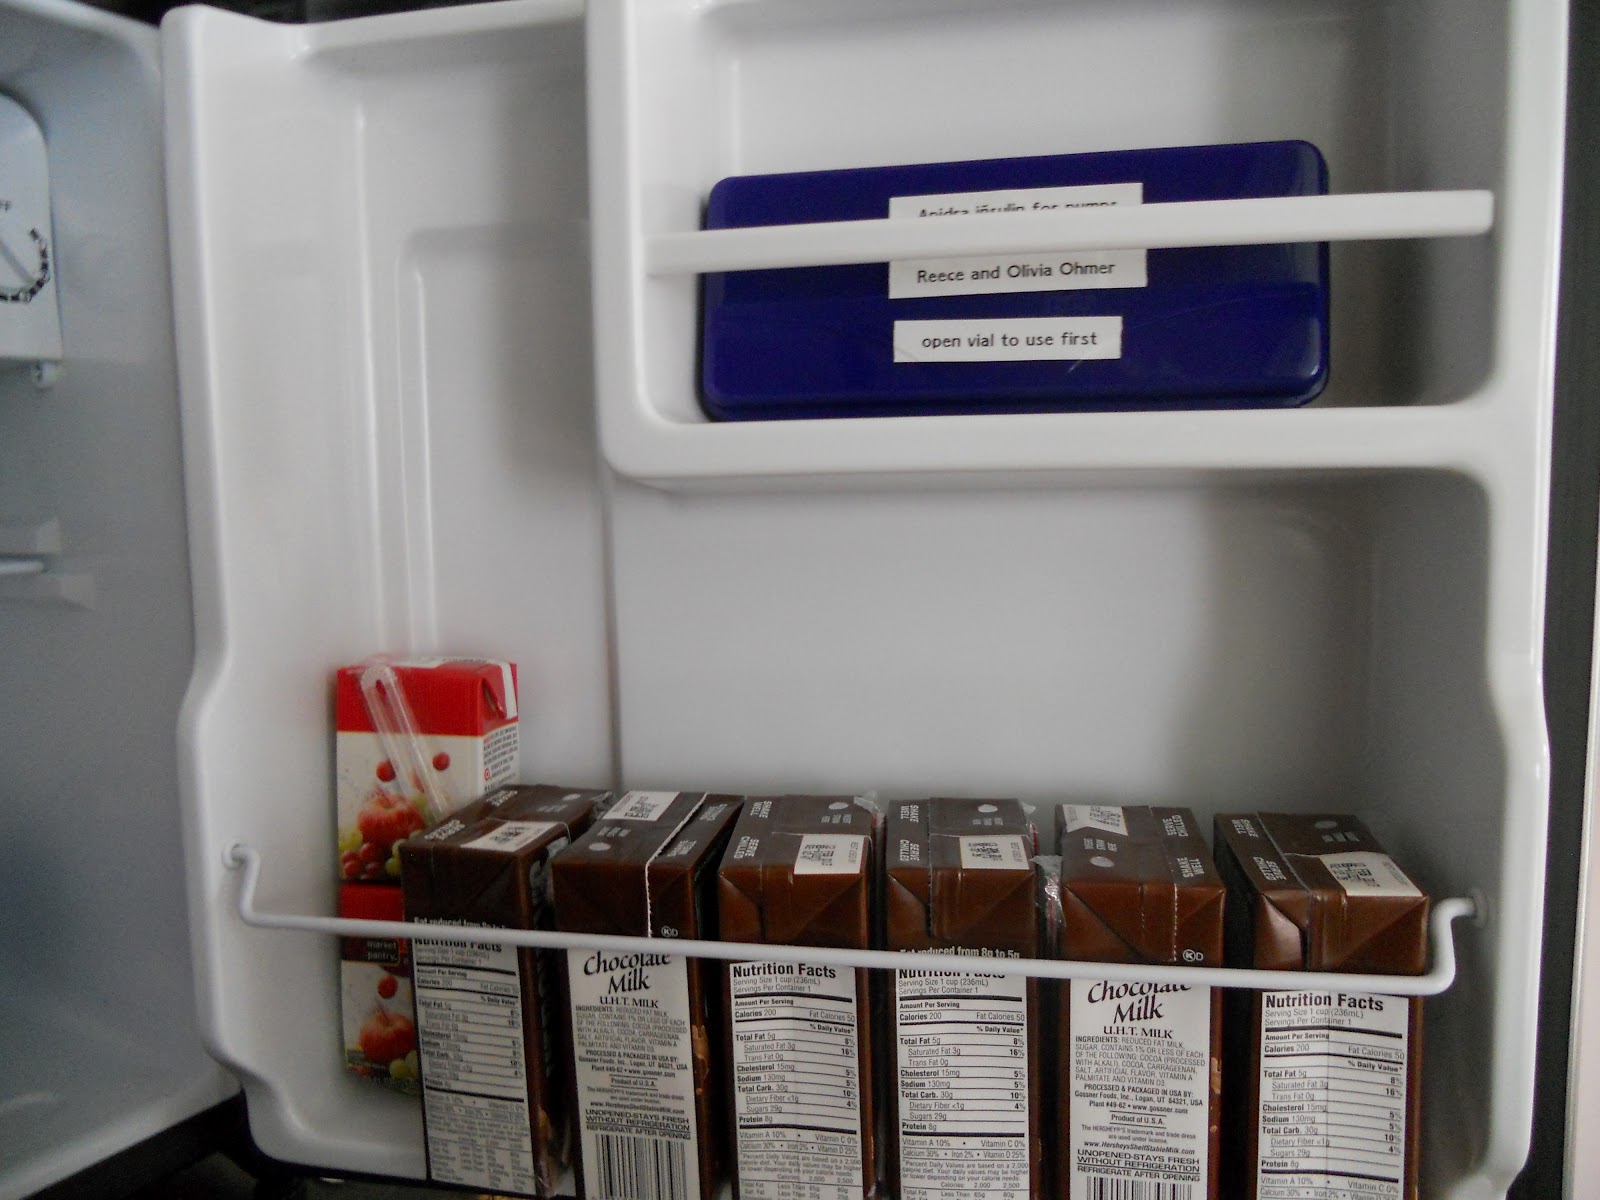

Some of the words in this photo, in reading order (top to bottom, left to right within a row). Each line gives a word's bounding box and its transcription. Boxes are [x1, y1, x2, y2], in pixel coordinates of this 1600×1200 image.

[917, 270, 964, 283] Reece
[971, 266, 1000, 280] and
[1007, 264, 1052, 278] Olivia
[1060, 262, 1115, 276] Ohmer
[922, 336, 961, 349] open
[968, 334, 993, 347] vial
[1001, 334, 1019, 346] to
[1027, 335, 1053, 346] use
[1061, 332, 1097, 345] first
[759, 801, 772, 818] SHAKE
[910, 805, 918, 822] SHAKE
[745, 839, 759, 857] SERVE
[910, 844, 919, 861] SERVE
[733, 963, 794, 978] Nutrition
[798, 964, 836, 978] Facts
[608, 968, 650, 994] Milk
[899, 979, 922, 987] Serving
[899, 987, 926, 995] Servings
[632, 999, 658, 1008] MILK
[1266, 993, 1332, 1008] Nutrition
[1338, 994, 1383, 1011] Facts
[1114, 995, 1164, 1024] Milk
[1142, 1027, 1173, 1039] MILK
[1101, 1044, 1133, 1052] CONTAINS
[1186, 1050, 1203, 1058] EACH
[1265, 1045, 1294, 1053] Calories
[942, 1070, 960, 1078] 15mg
[928, 1081, 950, 1089] 130mg
[1084, 1083, 1119, 1092] PROCESSED
[1128, 1086, 1159, 1095] PACKAGED
[941, 1091, 953, 1099] 30g
[910, 1102, 933, 1110] Dietary
[1089, 1100, 1104, 1108] Plant
[662, 1116, 689, 1124] FRESH
[910, 1112, 932, 1120] Sugars
[935, 1112, 946, 1120] 29g
[1111, 1114, 1135, 1122] Product
[902, 1122, 926, 1130] Protein
[929, 1123, 936, 1131] 8g
[635, 1128, 656, 1136] AFTER
[660, 1131, 690, 1140] OPENING
[1078, 1156, 1121, 1166] WITHOUT
[1124, 1160, 1200, 1172] REFRIGERATION
[1168, 1156, 1200, 1165] FRESH
[1078, 1166, 1132, 1176] REFRIGERATE
[1134, 1171, 1160, 1179] AFTER
[1162, 1173, 1200, 1181] OPENING
